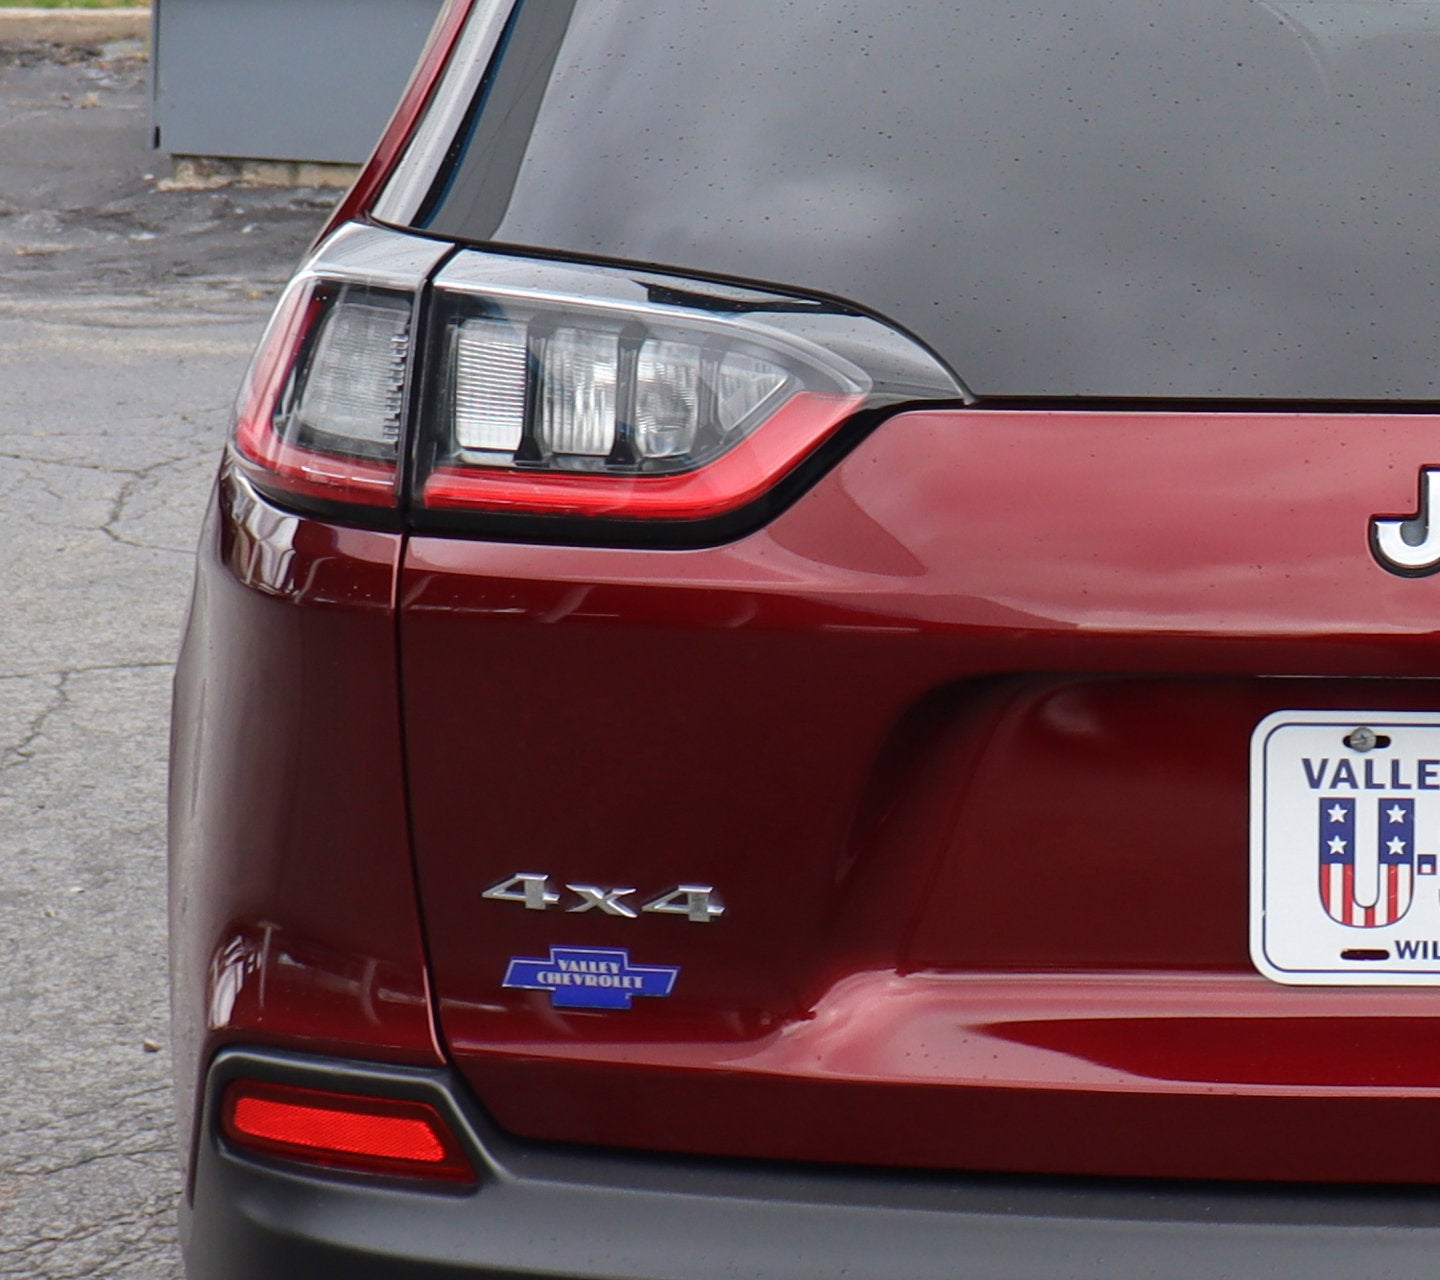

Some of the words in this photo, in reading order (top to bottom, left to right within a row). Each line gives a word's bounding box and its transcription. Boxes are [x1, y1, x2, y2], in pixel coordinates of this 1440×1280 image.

[481, 872, 726, 923] 4x4
[557, 958, 621, 975] VALLEY
[536, 970, 644, 989] CHEVROLET
